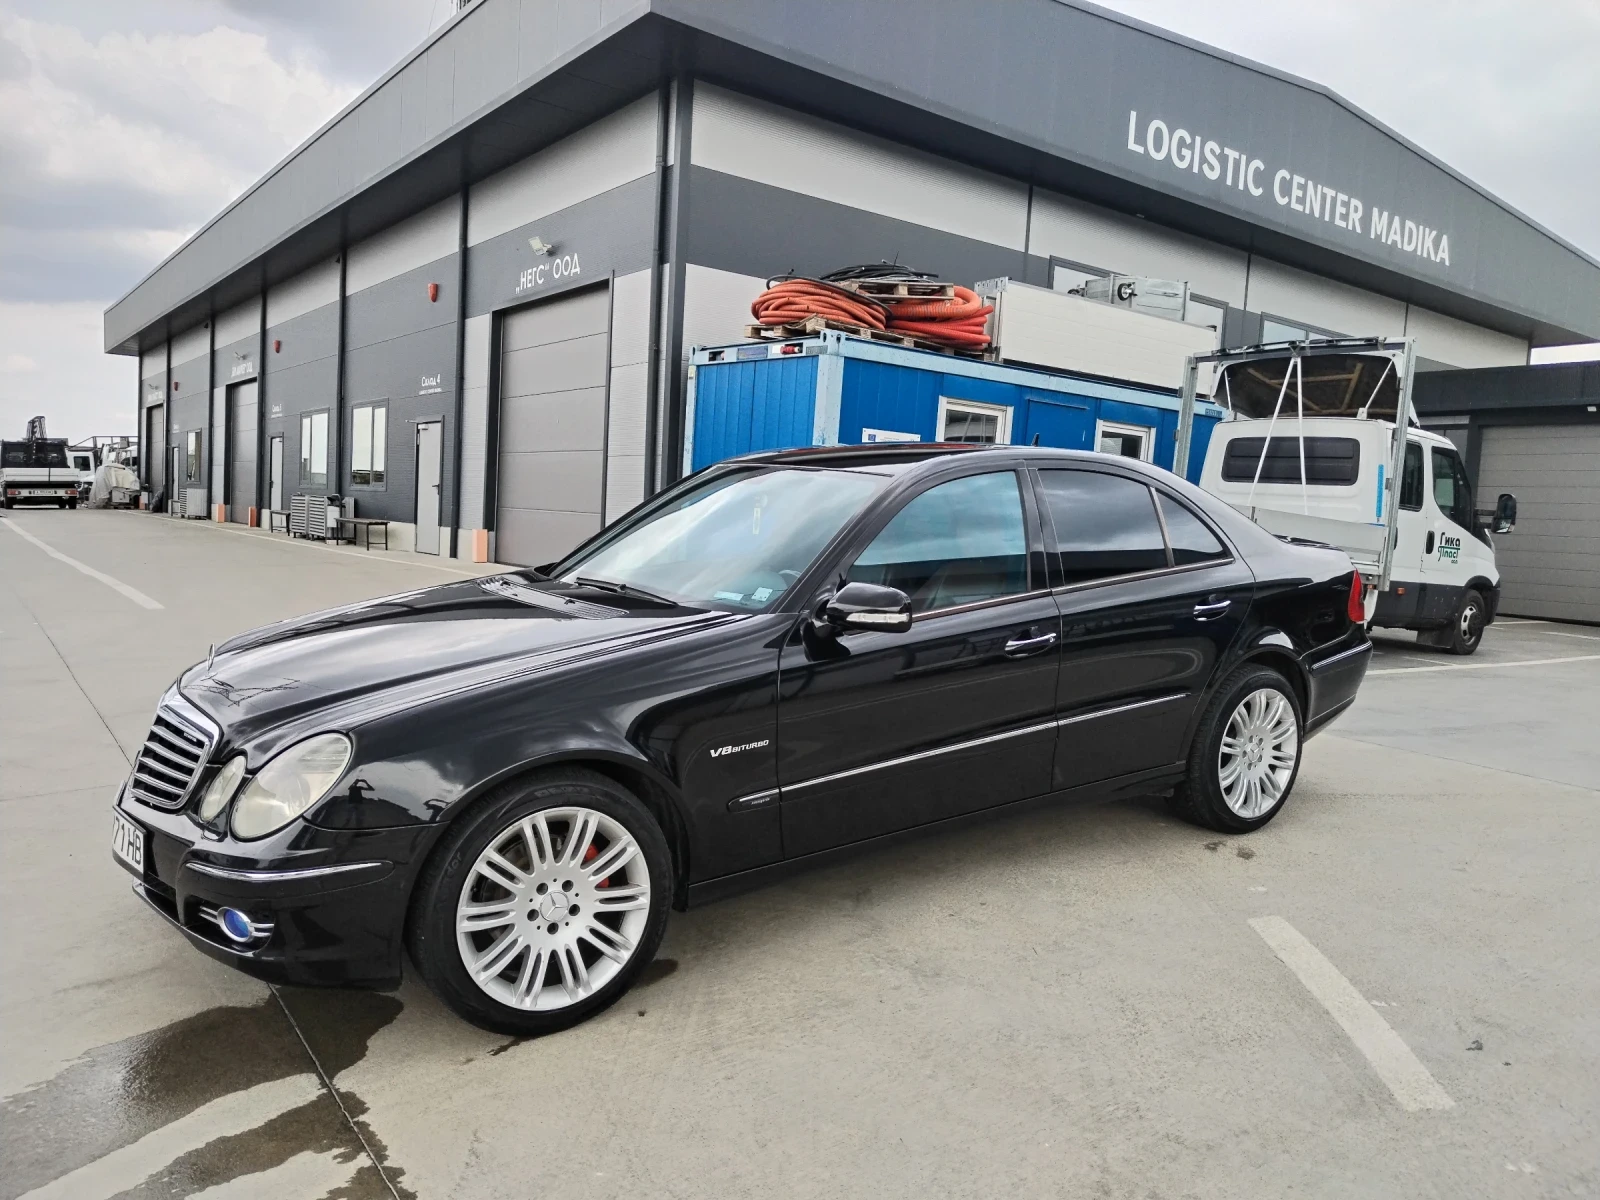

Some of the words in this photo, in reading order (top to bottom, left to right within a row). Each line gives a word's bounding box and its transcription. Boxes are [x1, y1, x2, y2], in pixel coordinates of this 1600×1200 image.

[1127, 110, 1264, 197] LOGISTIC
[1273, 169, 1362, 234] CENTER
[1370, 207, 1450, 266] MADIKA
[553, 253, 580, 279] ООД
